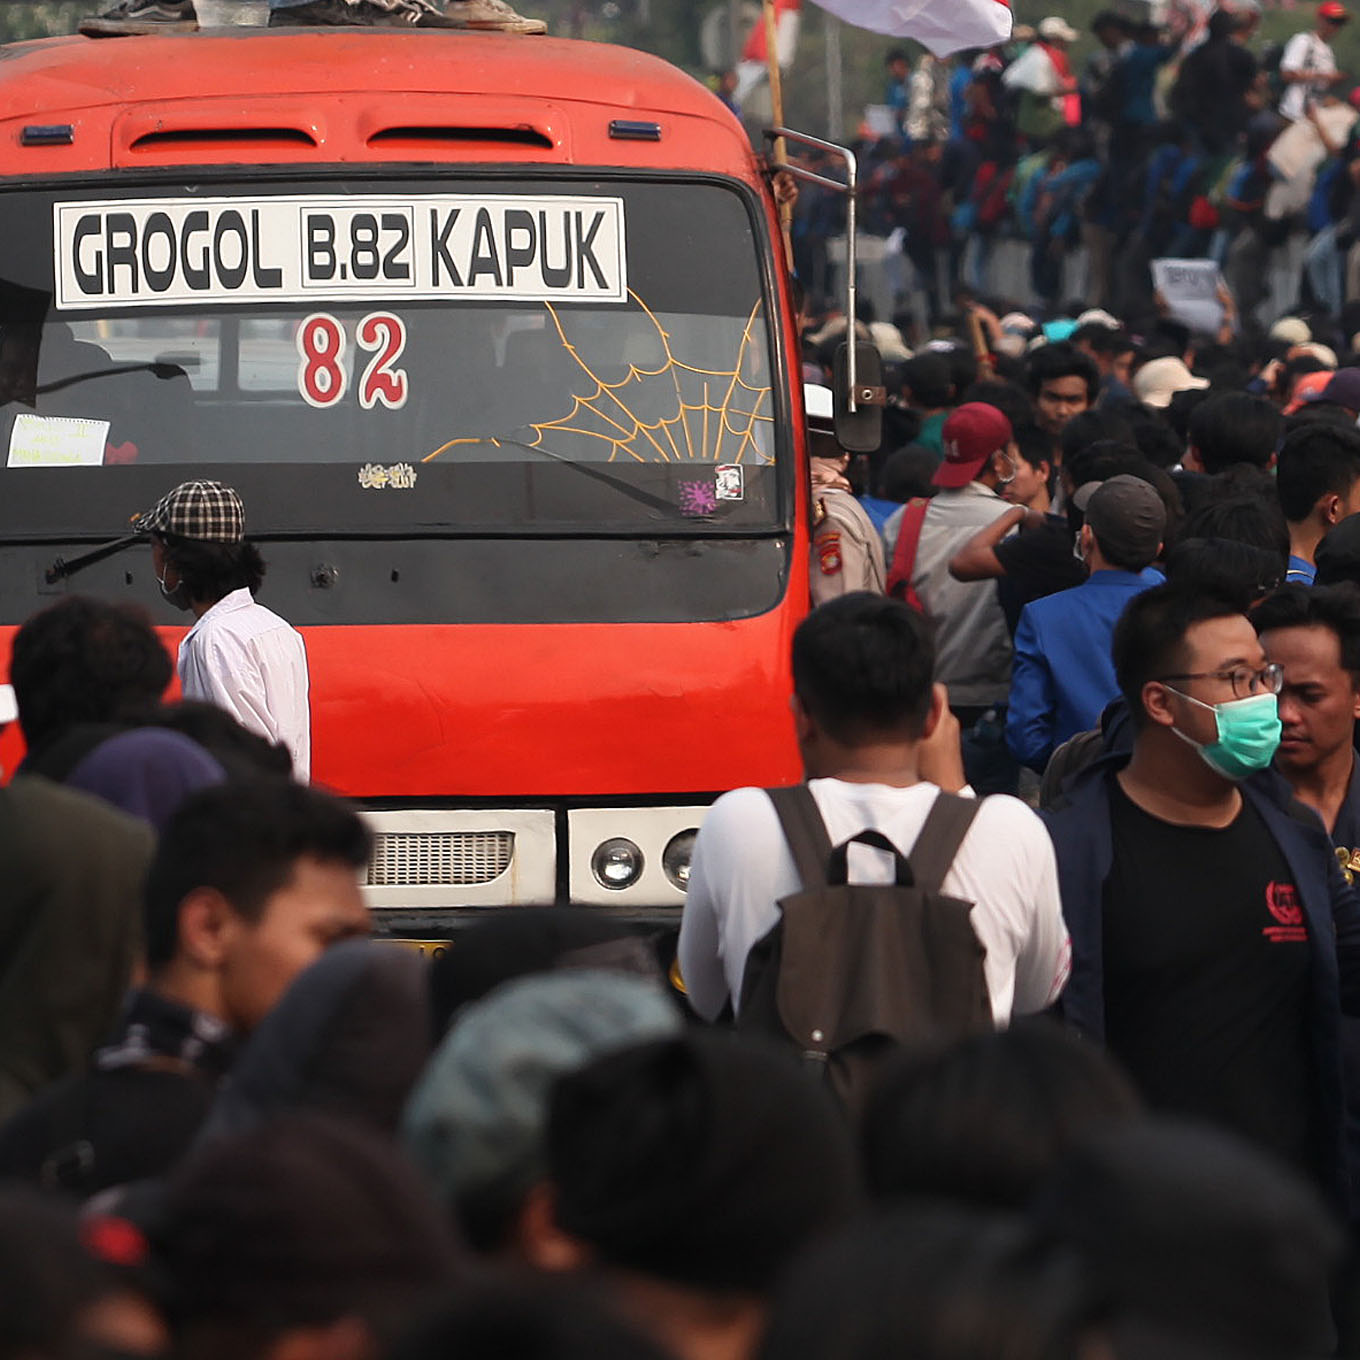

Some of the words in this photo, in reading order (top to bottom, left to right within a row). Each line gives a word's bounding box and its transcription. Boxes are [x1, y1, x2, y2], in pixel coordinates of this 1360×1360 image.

[72, 208, 283, 295] GROGOL
[307, 213, 411, 280] B.82
[430, 207, 611, 289] KAPUK
[296, 310, 408, 410] 82
